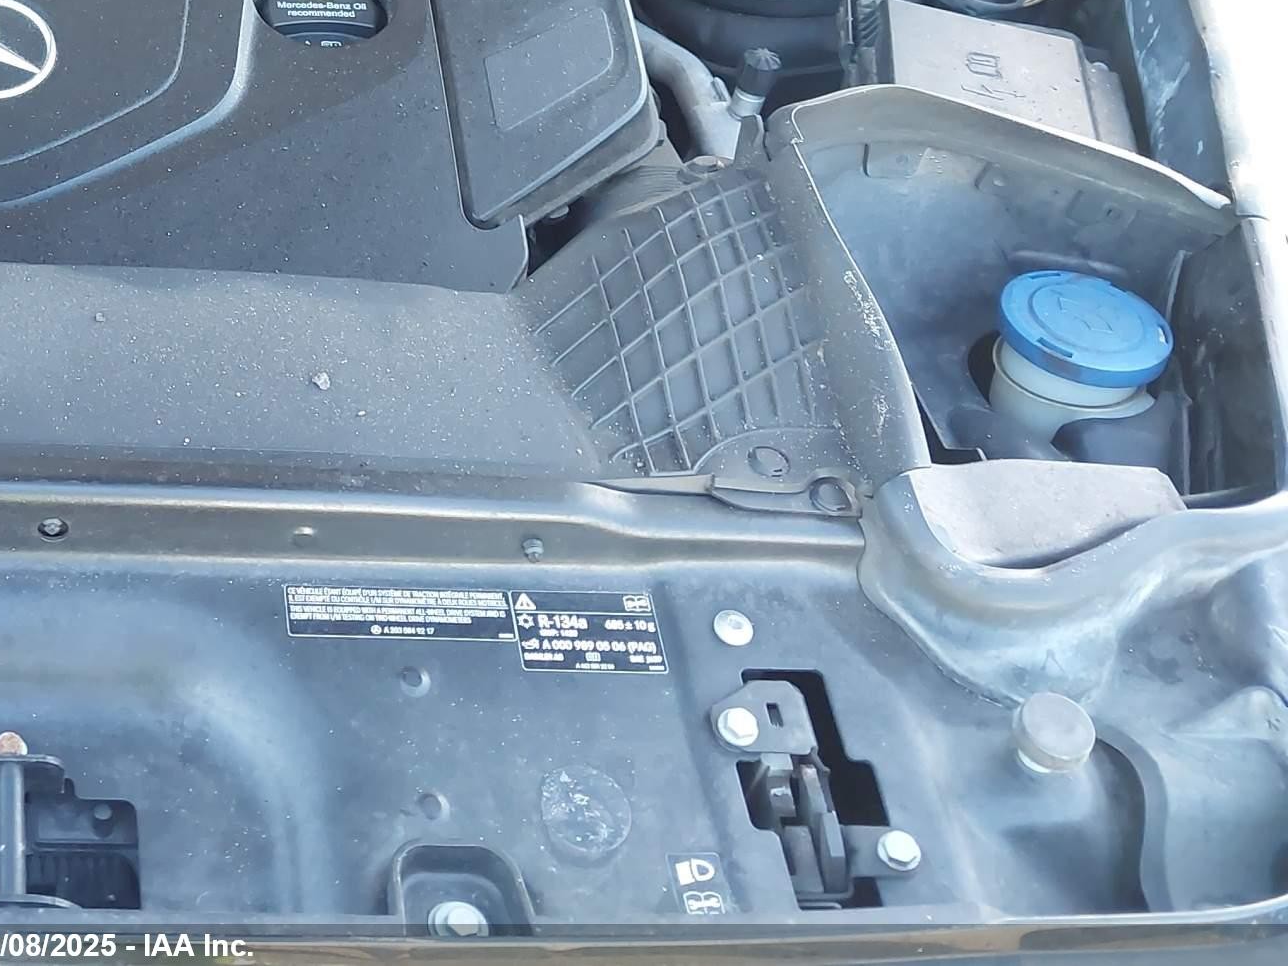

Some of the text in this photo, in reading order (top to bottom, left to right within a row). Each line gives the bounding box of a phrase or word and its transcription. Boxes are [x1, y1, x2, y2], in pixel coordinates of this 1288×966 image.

[276, 1, 367, 11] Mercedes-Benz Oil
[287, 10, 356, 18] recommended
[538, 614, 588, 630] R-134a
[634, 620, 647, 631] 10
[648, 622, 656, 633] g
[543, 639, 551, 650] A
[552, 640, 573, 650] 000
[628, 641, 657, 654] (PAG)
